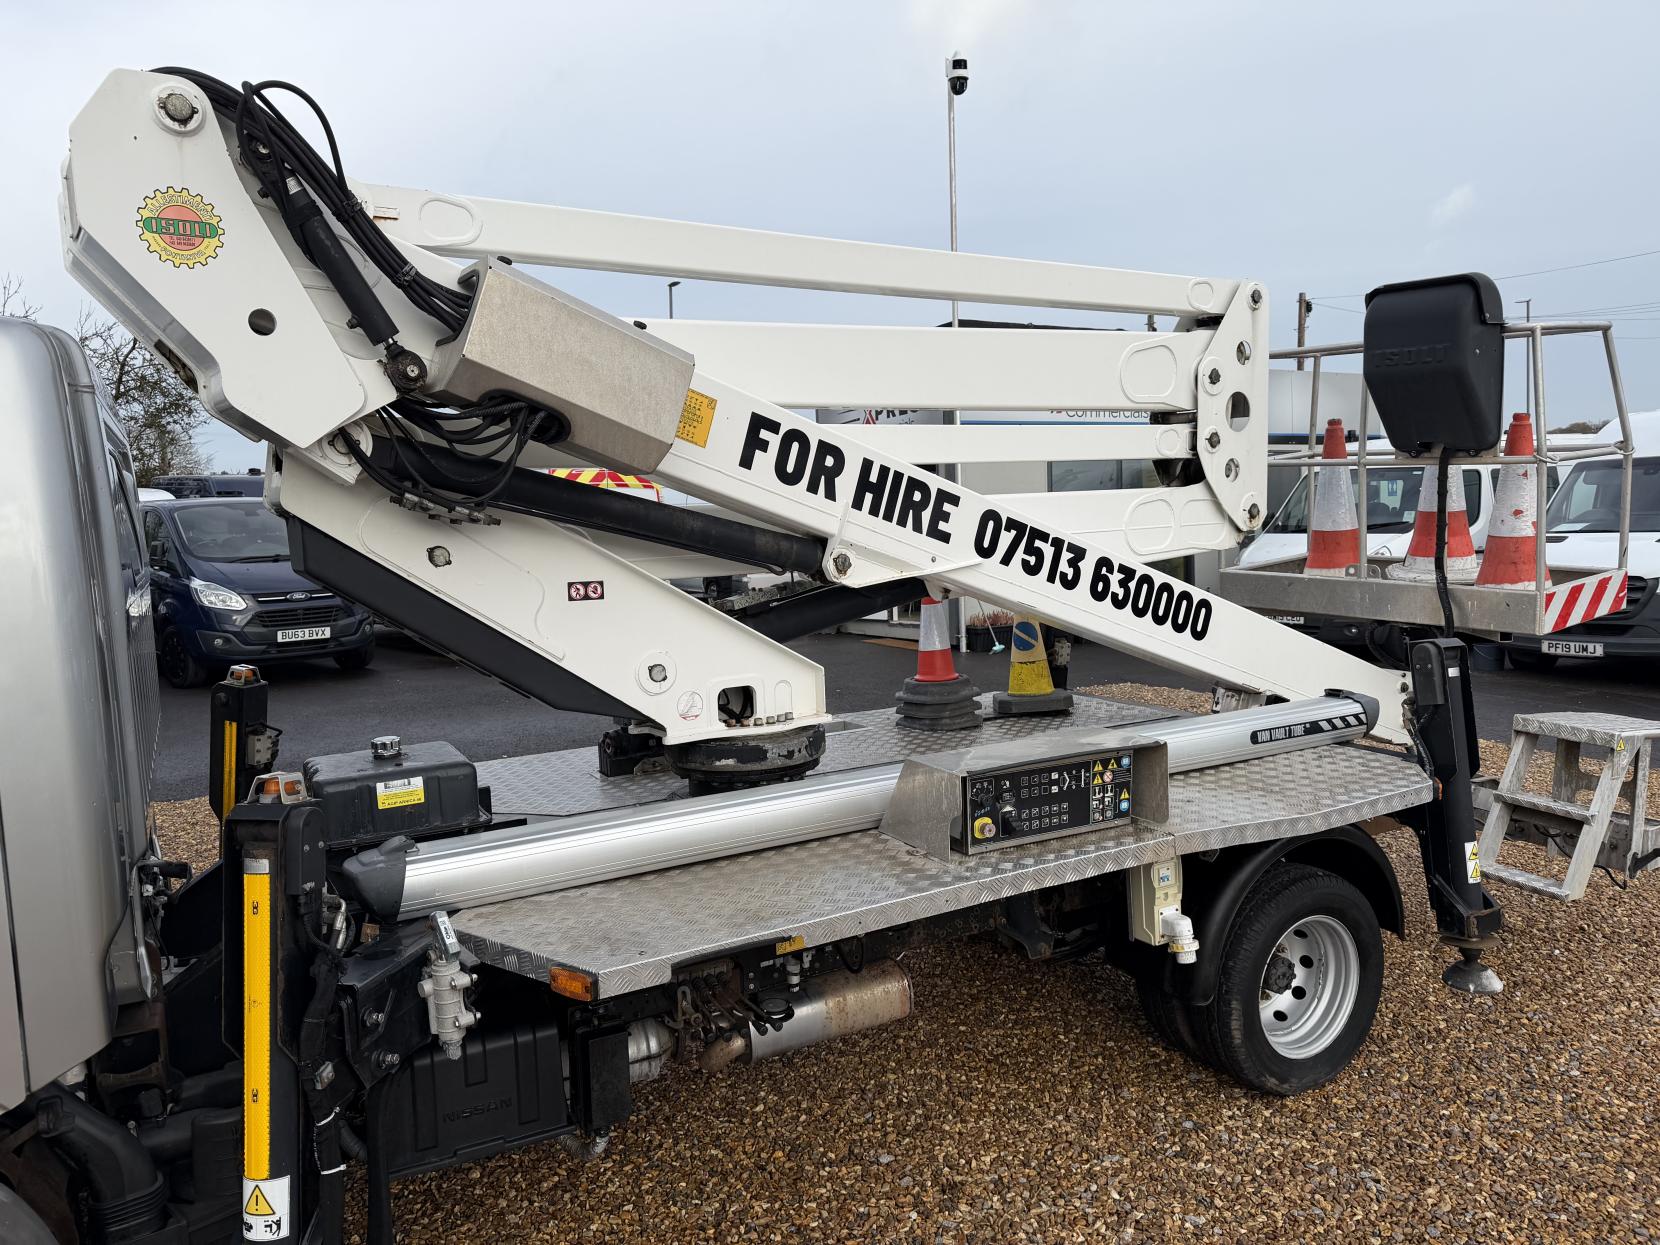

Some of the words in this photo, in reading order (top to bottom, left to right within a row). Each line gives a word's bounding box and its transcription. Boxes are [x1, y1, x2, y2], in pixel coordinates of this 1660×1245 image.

[151, 218, 212, 239] ISOLI
[738, 411, 846, 503] FOR
[850, 457, 961, 545] HIRE
[974, 508, 1087, 591] 07513
[1089, 556, 1213, 641] 630000
[281, 630, 306, 640] BU63
[308, 628, 326, 638] BVX
[1547, 642, 1571, 653] PF19
[1574, 643, 1597, 655] UMJ
[1257, 729, 1271, 743] VAN
[1271, 726, 1290, 741] VAULT
[1290, 724, 1305, 737] TUBE
[442, 1098, 513, 1123] NISSAN
